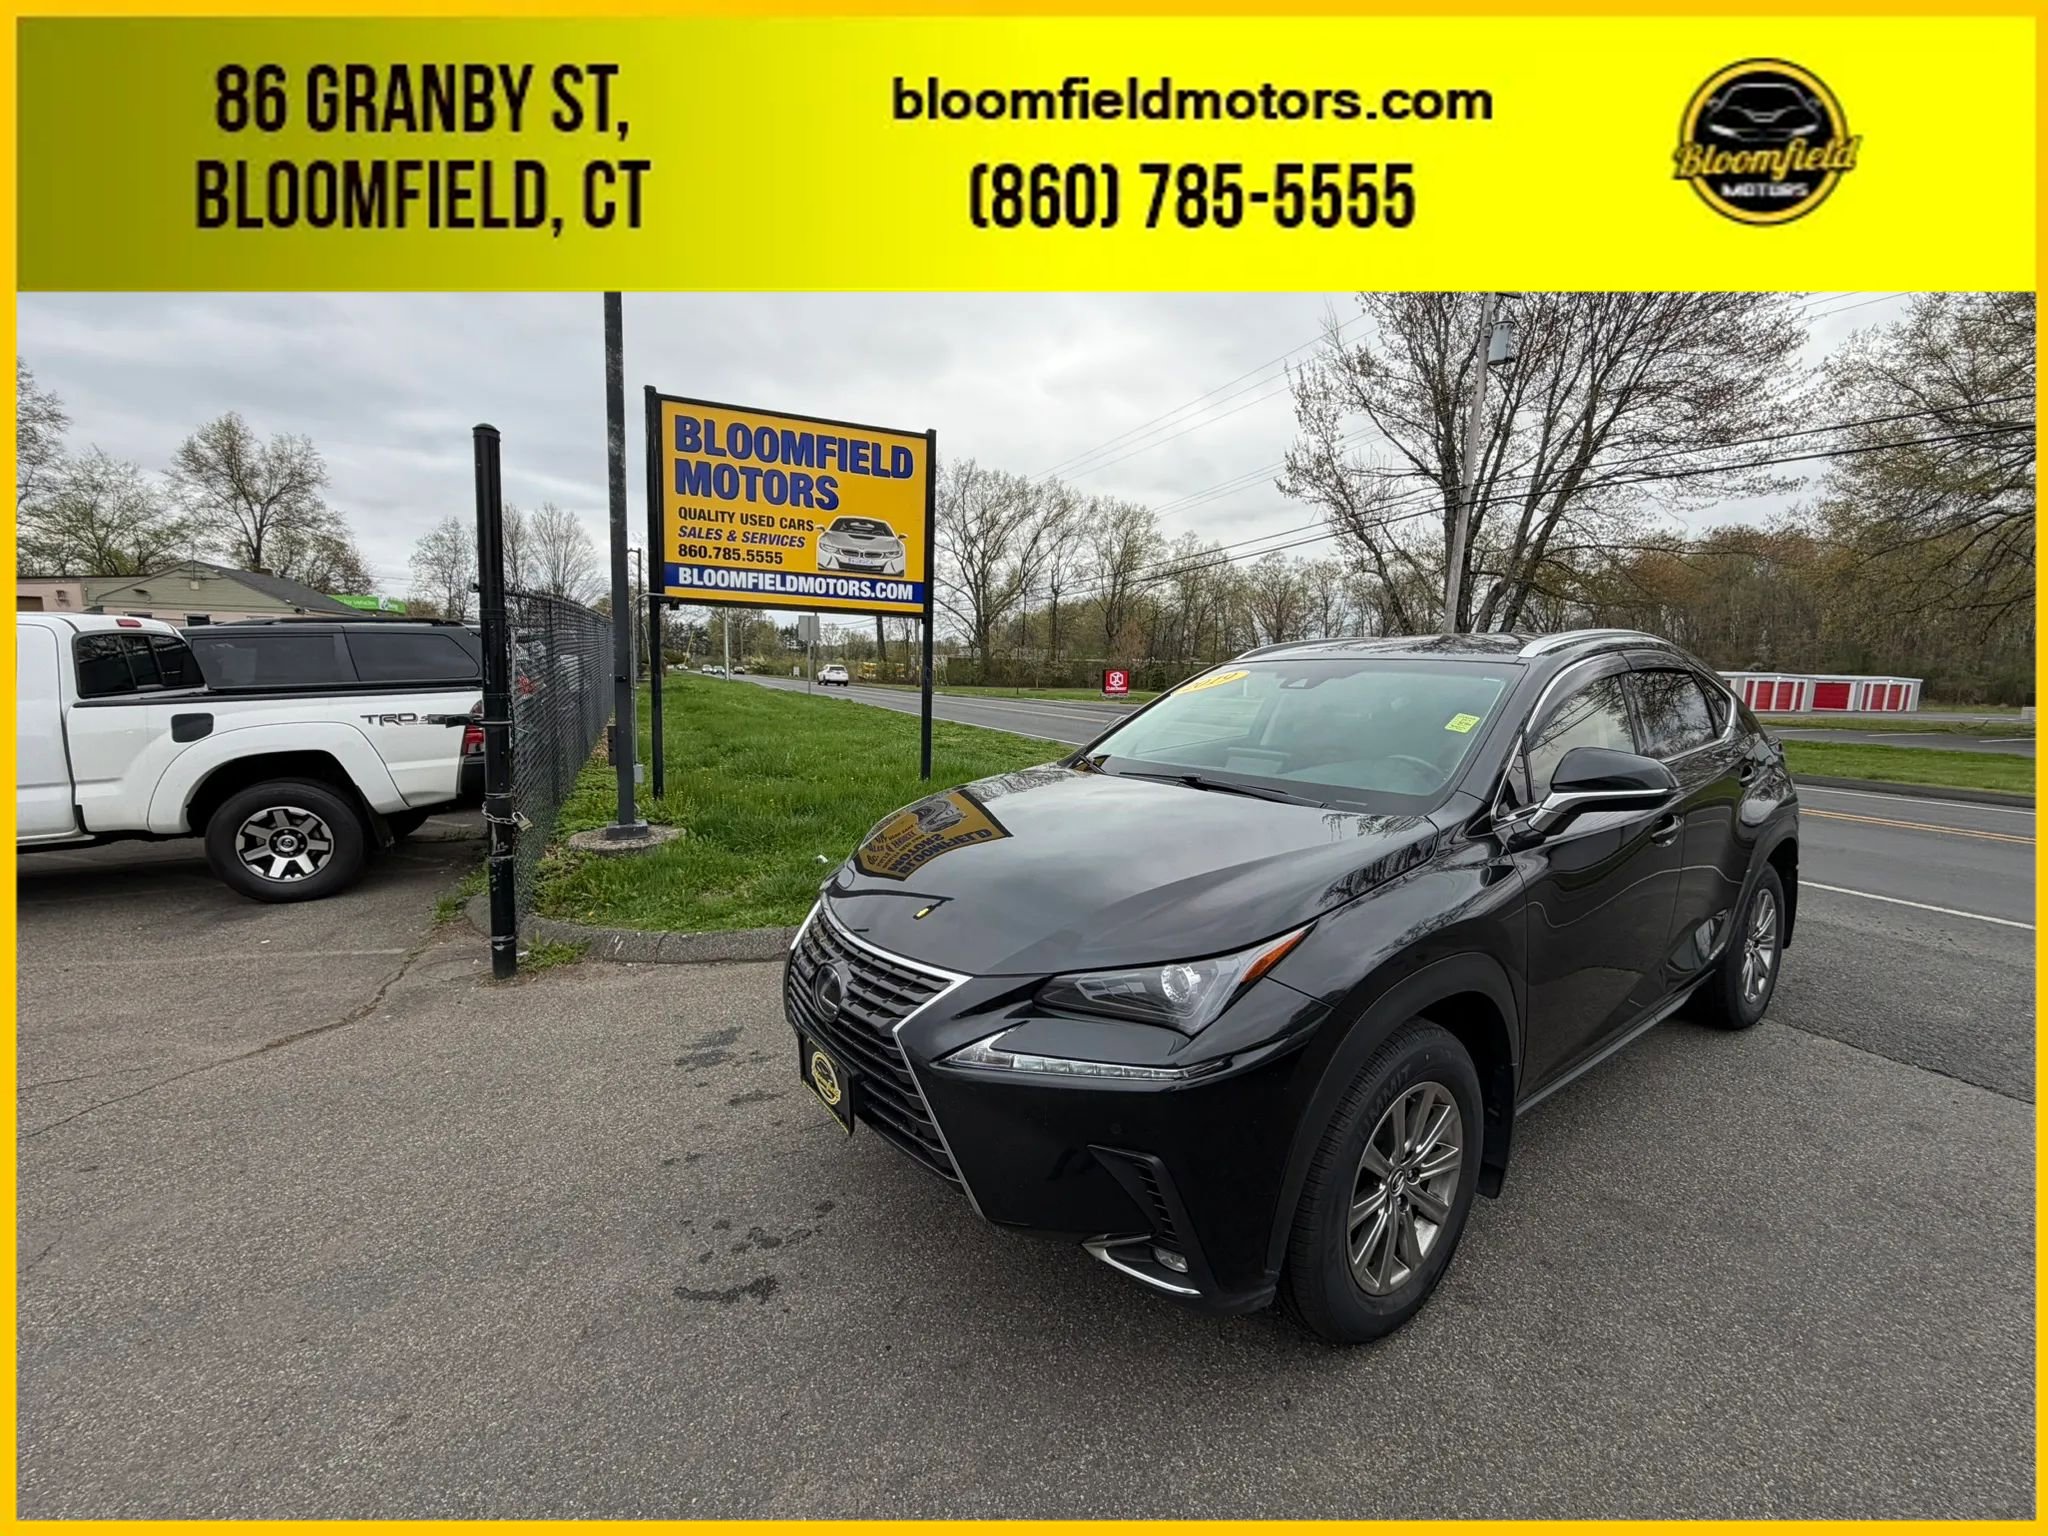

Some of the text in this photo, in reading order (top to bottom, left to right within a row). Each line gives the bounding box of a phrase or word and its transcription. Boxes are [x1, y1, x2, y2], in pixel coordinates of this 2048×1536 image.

[674, 414, 914, 480] BLOOMFIELD
[674, 458, 840, 511] MOTORS
[678, 506, 815, 532] QUALITY USED CARS
[678, 525, 806, 548] SALES & SERVICES
[678, 544, 783, 565] 860.785.5555
[678, 566, 914, 600] BLOOMFIELDMOTORS.COM
[360, 712, 418, 727] TRD
